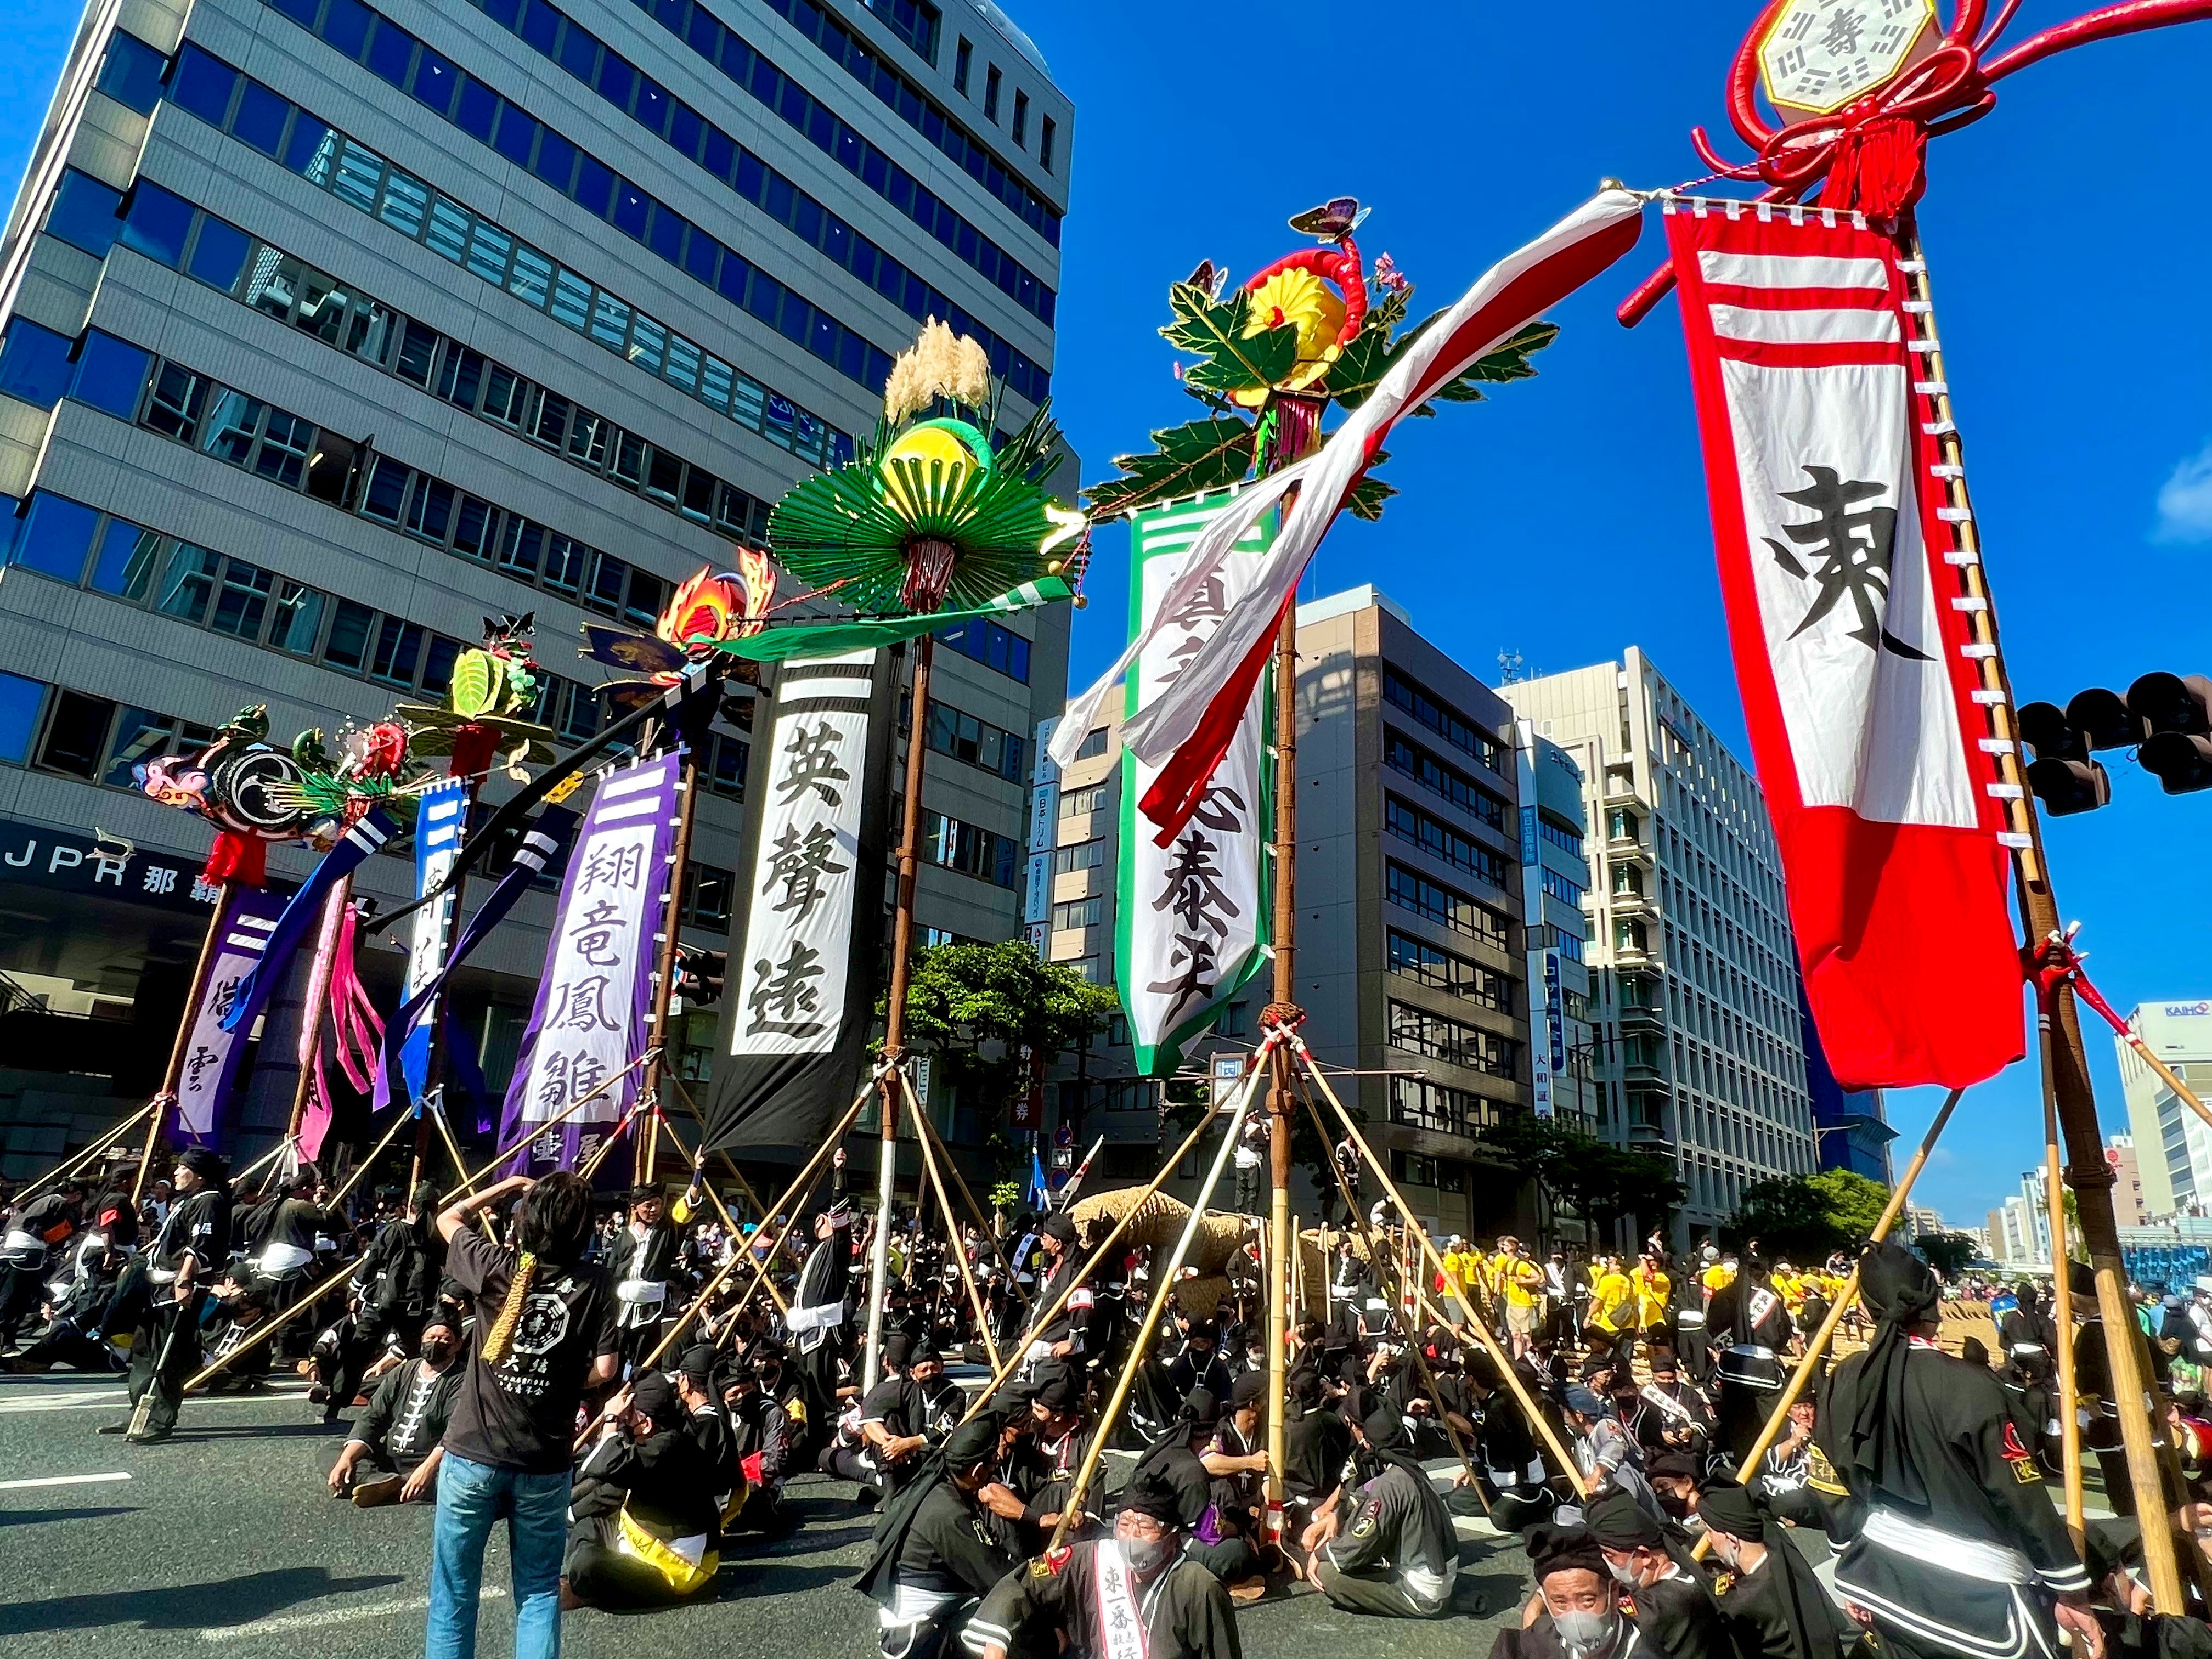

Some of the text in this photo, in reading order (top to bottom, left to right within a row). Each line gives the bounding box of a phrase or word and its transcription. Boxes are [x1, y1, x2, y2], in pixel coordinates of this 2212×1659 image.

[1760, 464, 1937, 662] 東
[1037, 798, 1047, 847] 日本トリム
